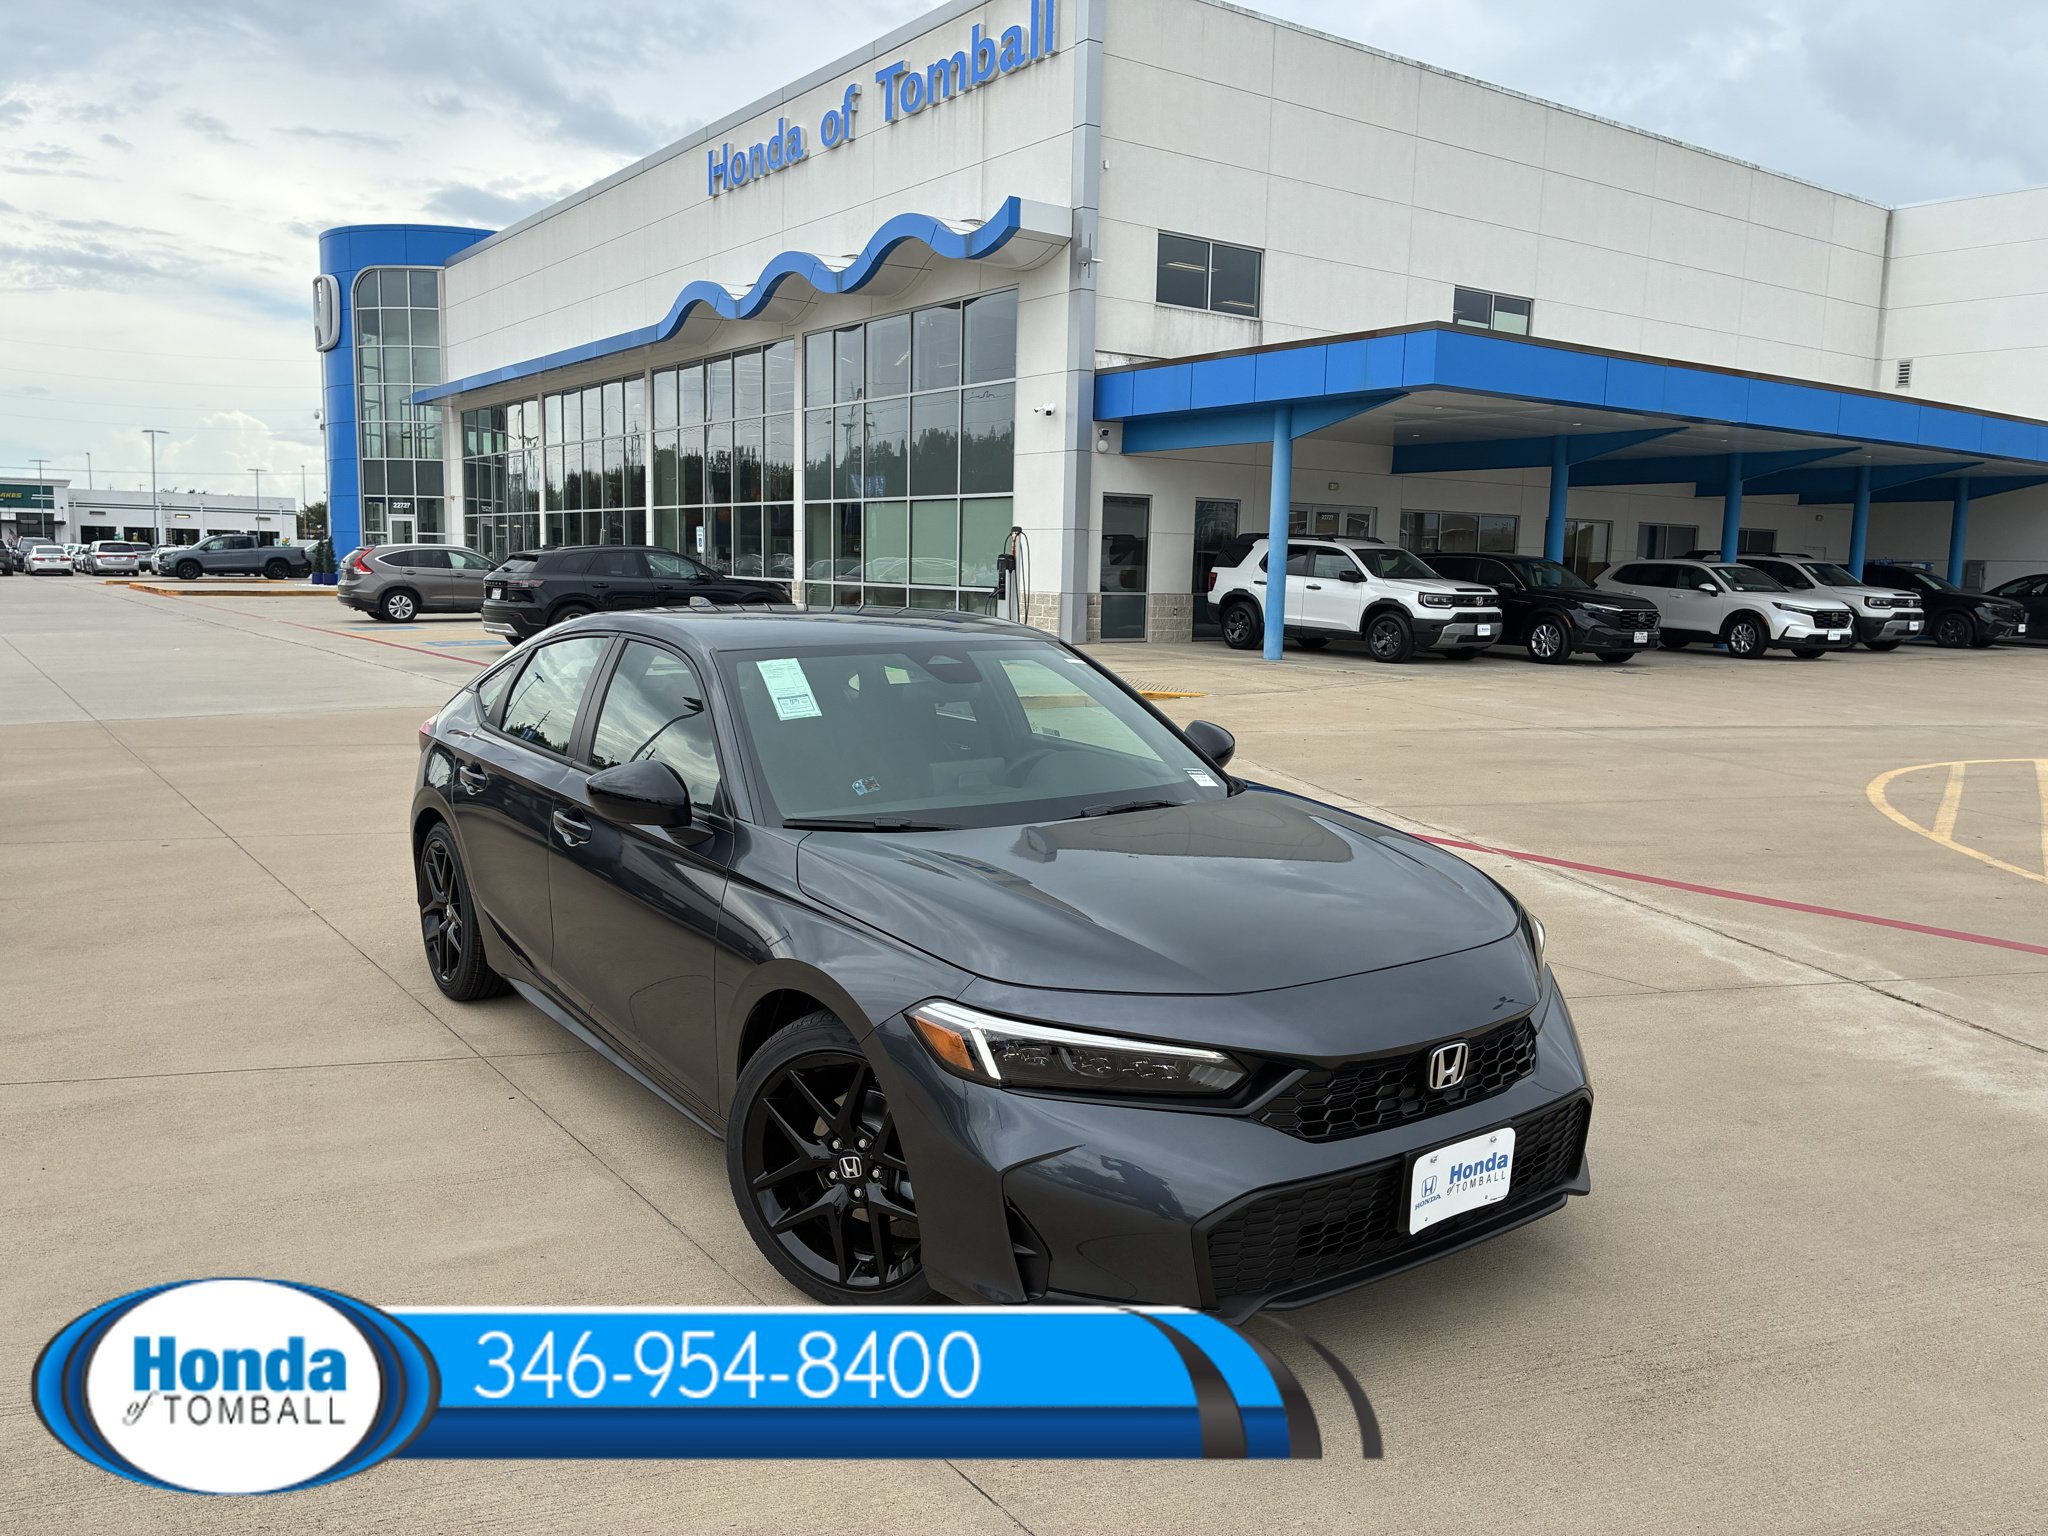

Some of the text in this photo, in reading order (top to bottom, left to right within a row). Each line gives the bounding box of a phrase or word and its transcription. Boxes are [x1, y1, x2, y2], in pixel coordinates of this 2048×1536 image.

[707, 0, 1060, 197] Honda of Tomball
[1449, 1152, 1509, 1184] Honda
[1456, 1170, 1506, 1193] TOMBALL
[1415, 1194, 1441, 1210] HONDA
